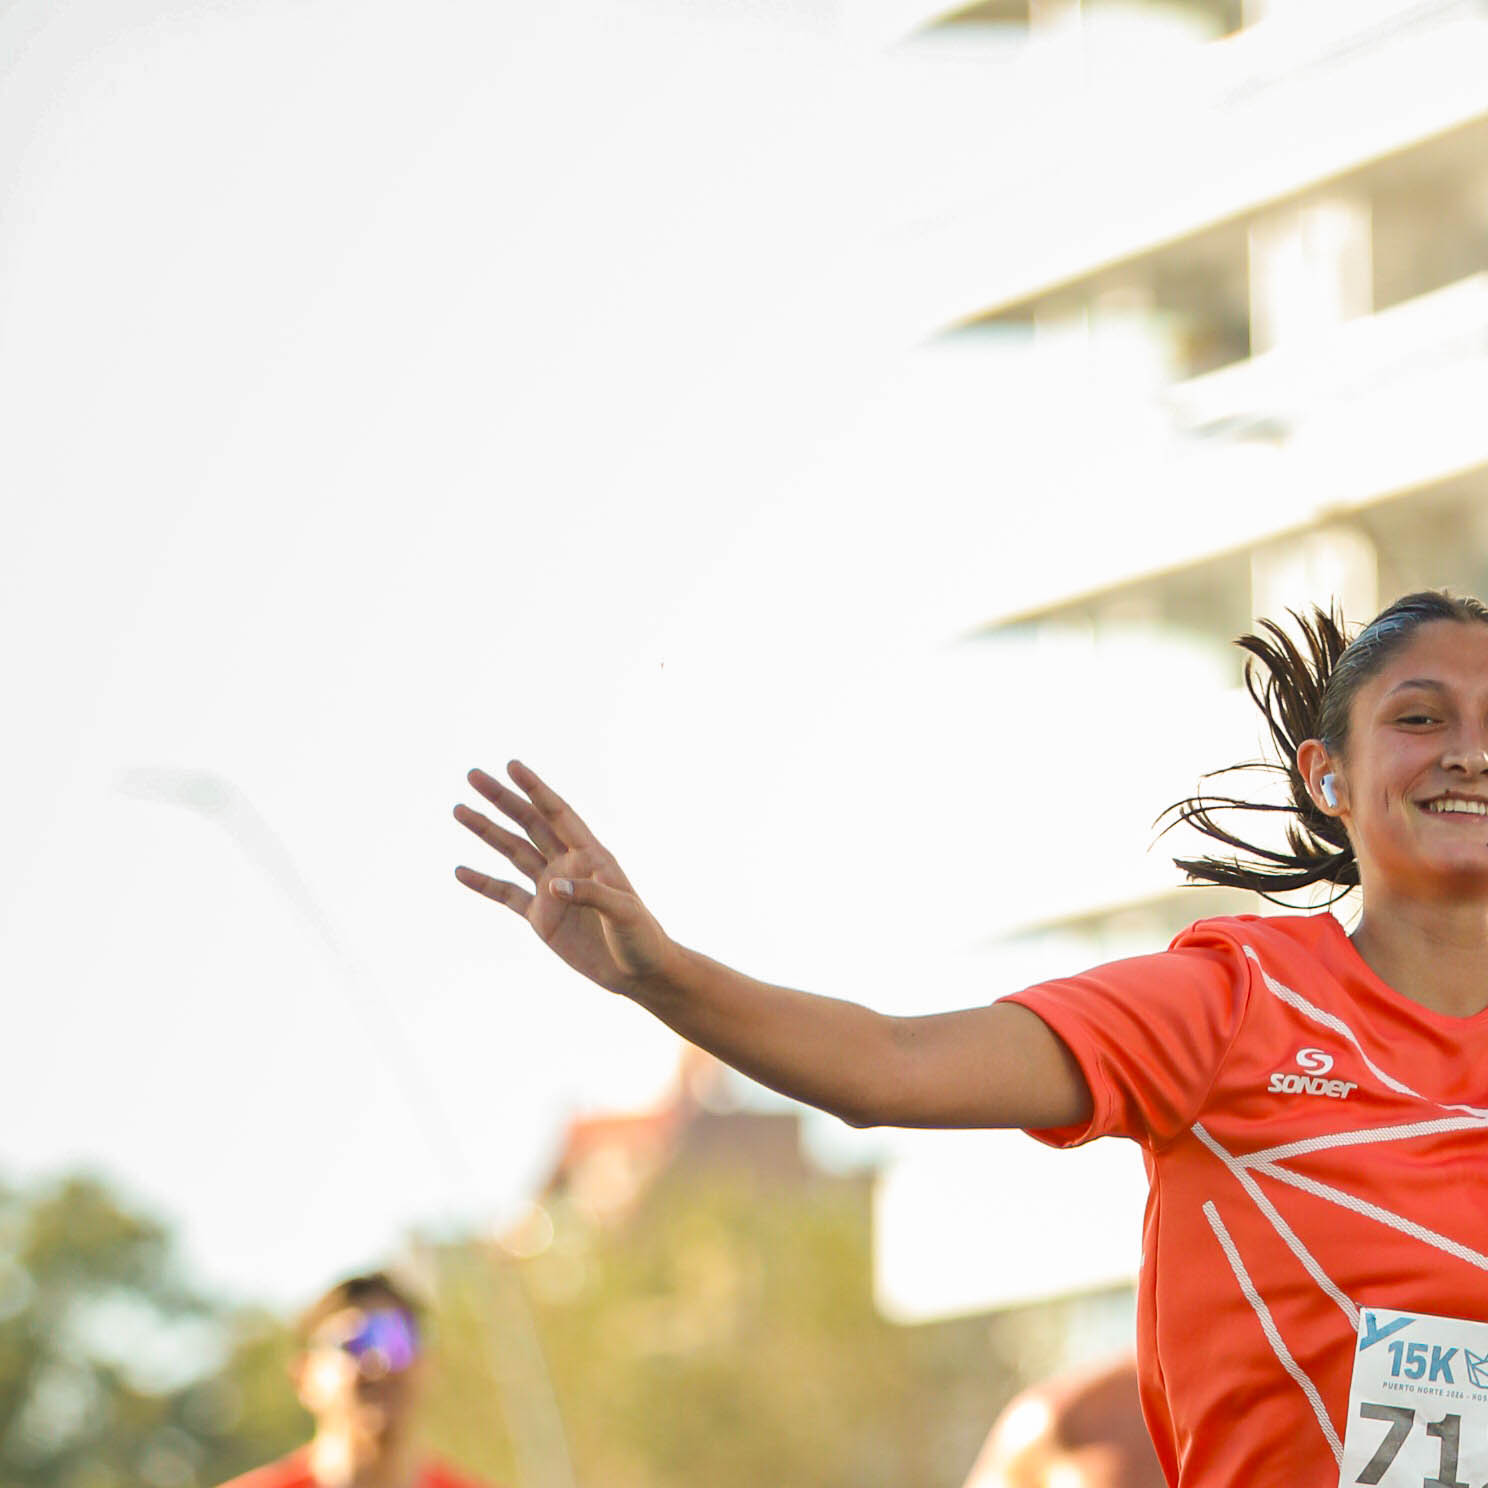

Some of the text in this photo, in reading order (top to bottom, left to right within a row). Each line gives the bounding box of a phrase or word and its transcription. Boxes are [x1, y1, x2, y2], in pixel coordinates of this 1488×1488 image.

[1387, 1340, 1460, 1385] 15K
[1383, 1381, 1415, 1393] PUERTO
[1417, 1386, 1442, 1396] NORTE
